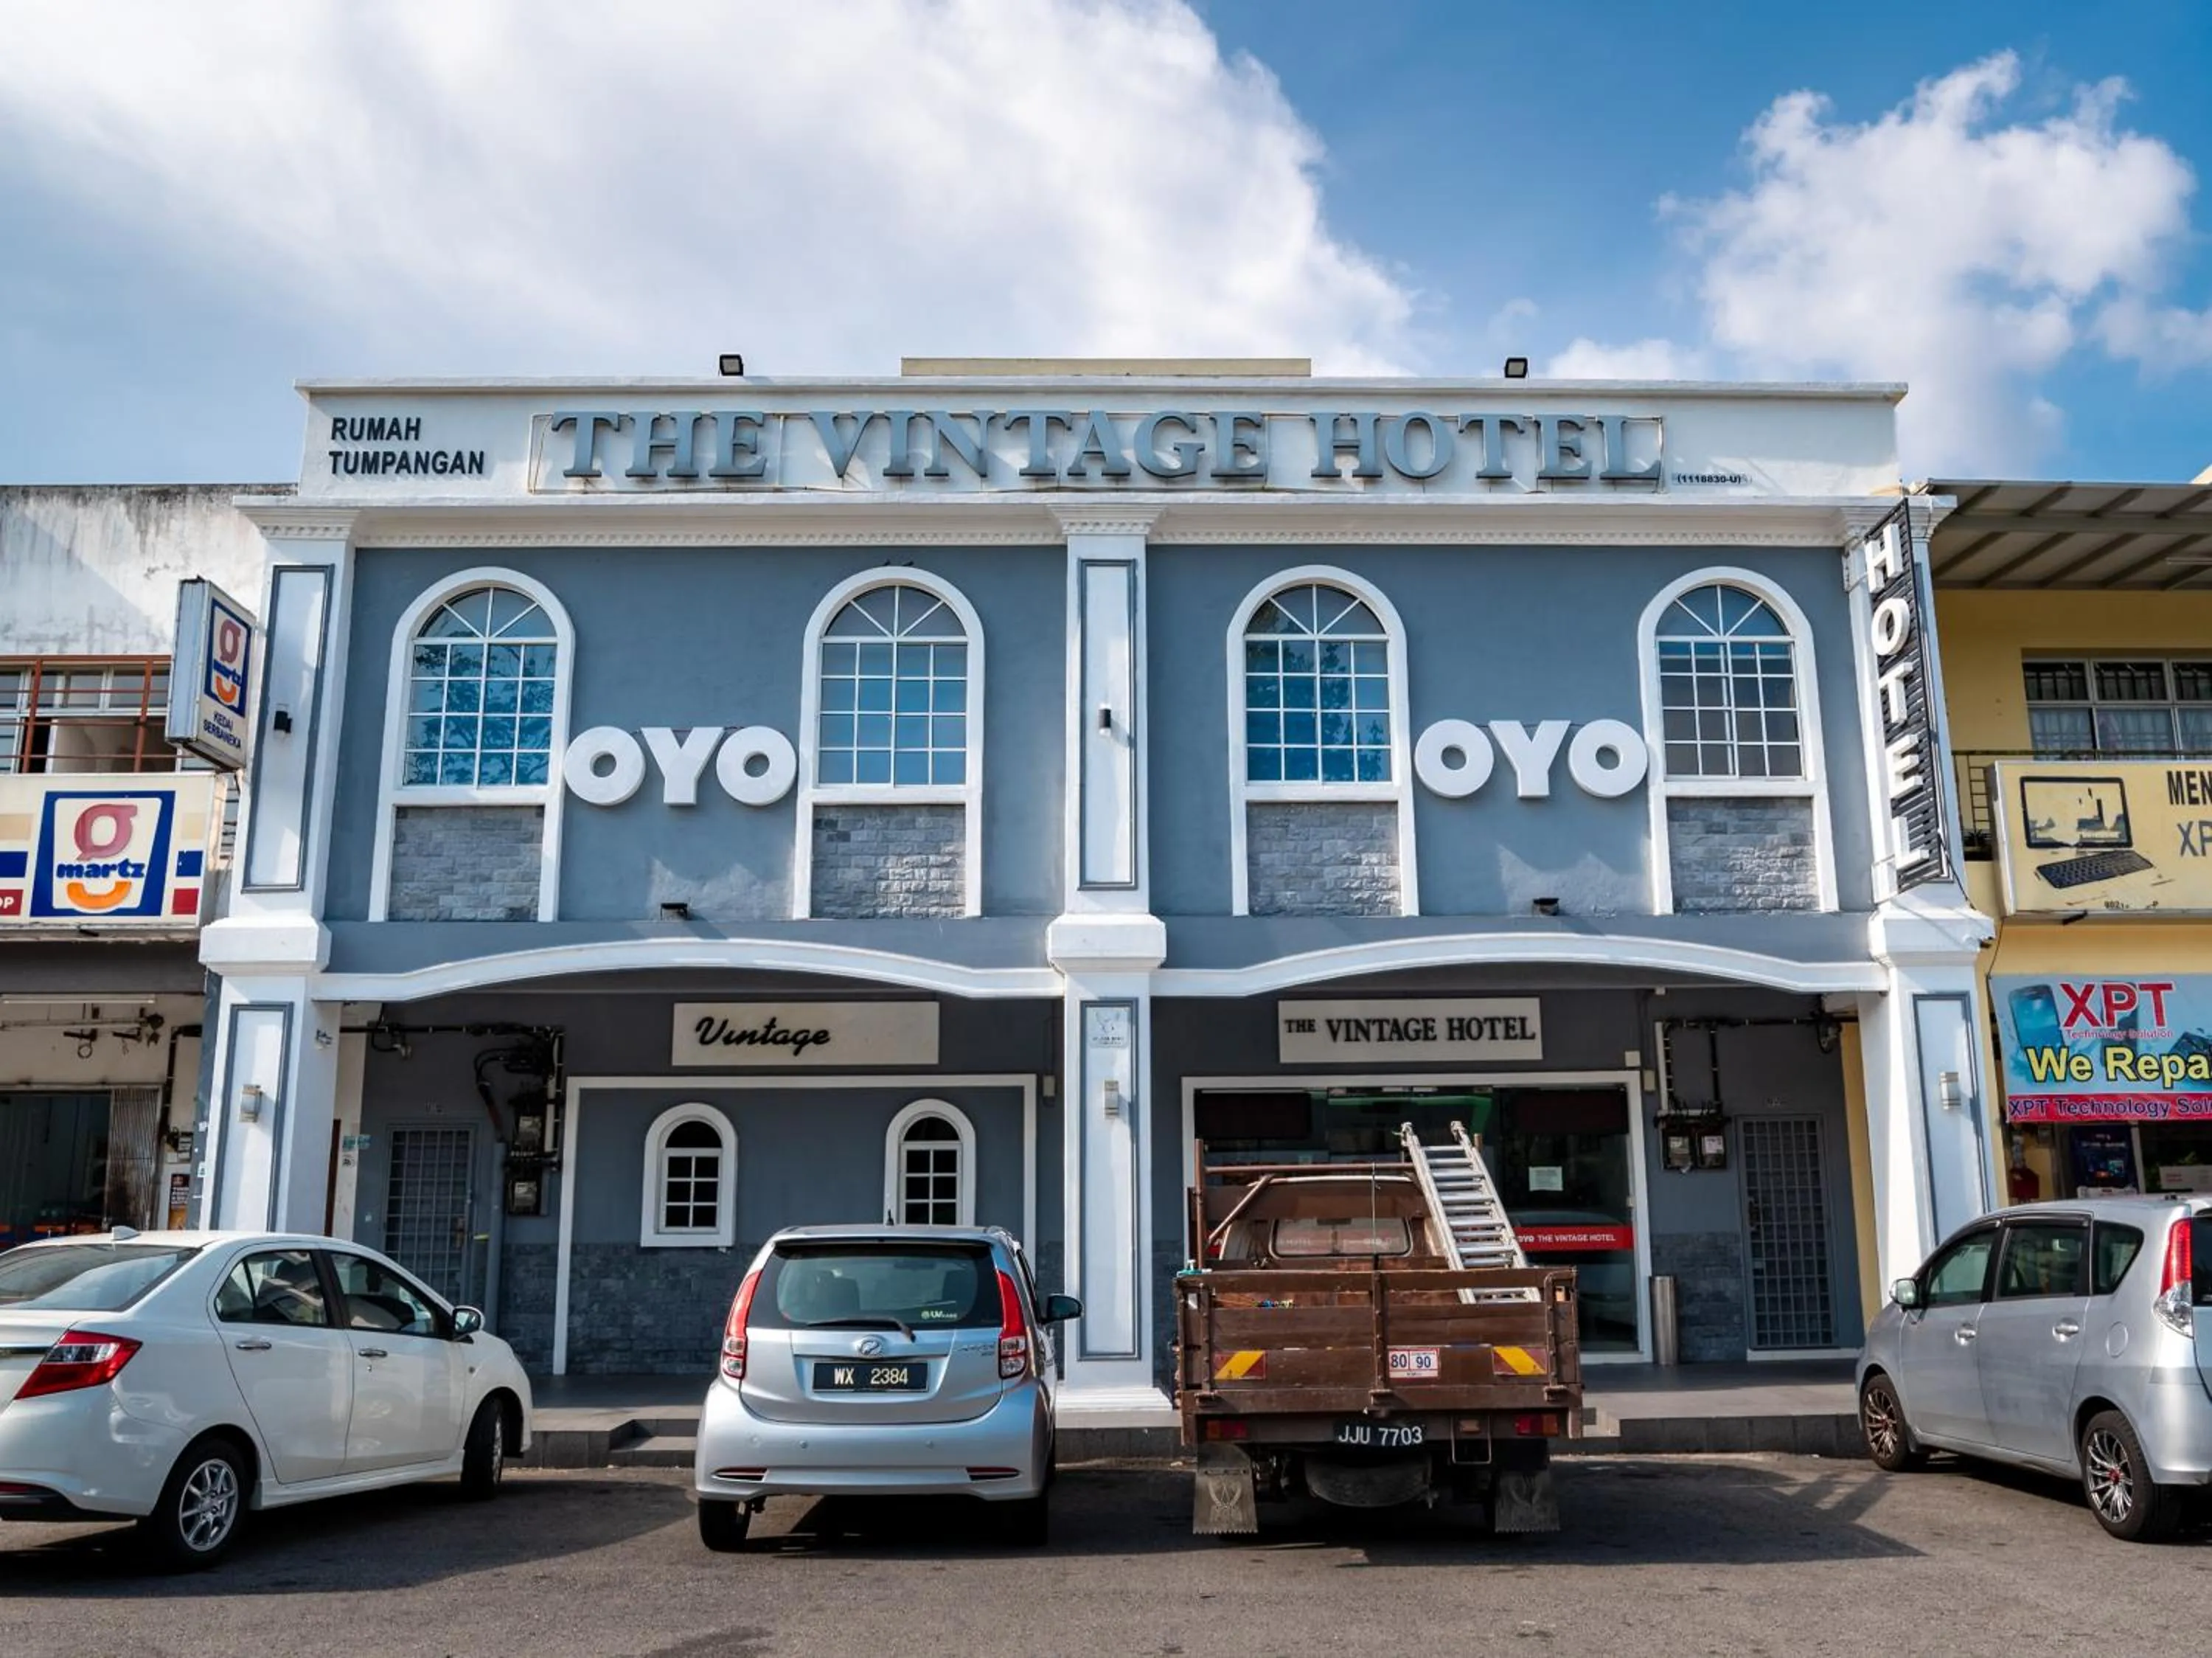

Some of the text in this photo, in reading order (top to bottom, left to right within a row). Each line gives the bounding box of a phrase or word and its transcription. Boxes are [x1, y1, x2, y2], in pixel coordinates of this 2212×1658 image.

[330, 417, 421, 441] RUMAH
[552, 410, 1661, 480] THE VINTAGE HOTEL
[329, 451, 484, 474] TUMPANGAN
[1865, 522, 1930, 870] HOTEL
[564, 726, 796, 806] OYO
[1414, 718, 1649, 799] OYO
[56, 858, 145, 878] martz
[2059, 982, 2173, 1028] XPT
[695, 1016, 830, 1057] Vintage
[1284, 1016, 1536, 1043] THE VINTAGE HOTEL
[2026, 1046, 2212, 1089] We Repa
[2008, 1100, 2048, 1116] XPT
[2056, 1097, 2170, 1117] Technology
[1537, 1235, 1554, 1243] THE
[1554, 1234, 1587, 1242] VINTAGE
[1391, 1354, 1431, 1368] 80 90
[834, 1367, 908, 1384] WX 2384
[1338, 1425, 1422, 1446] JJU 7703
